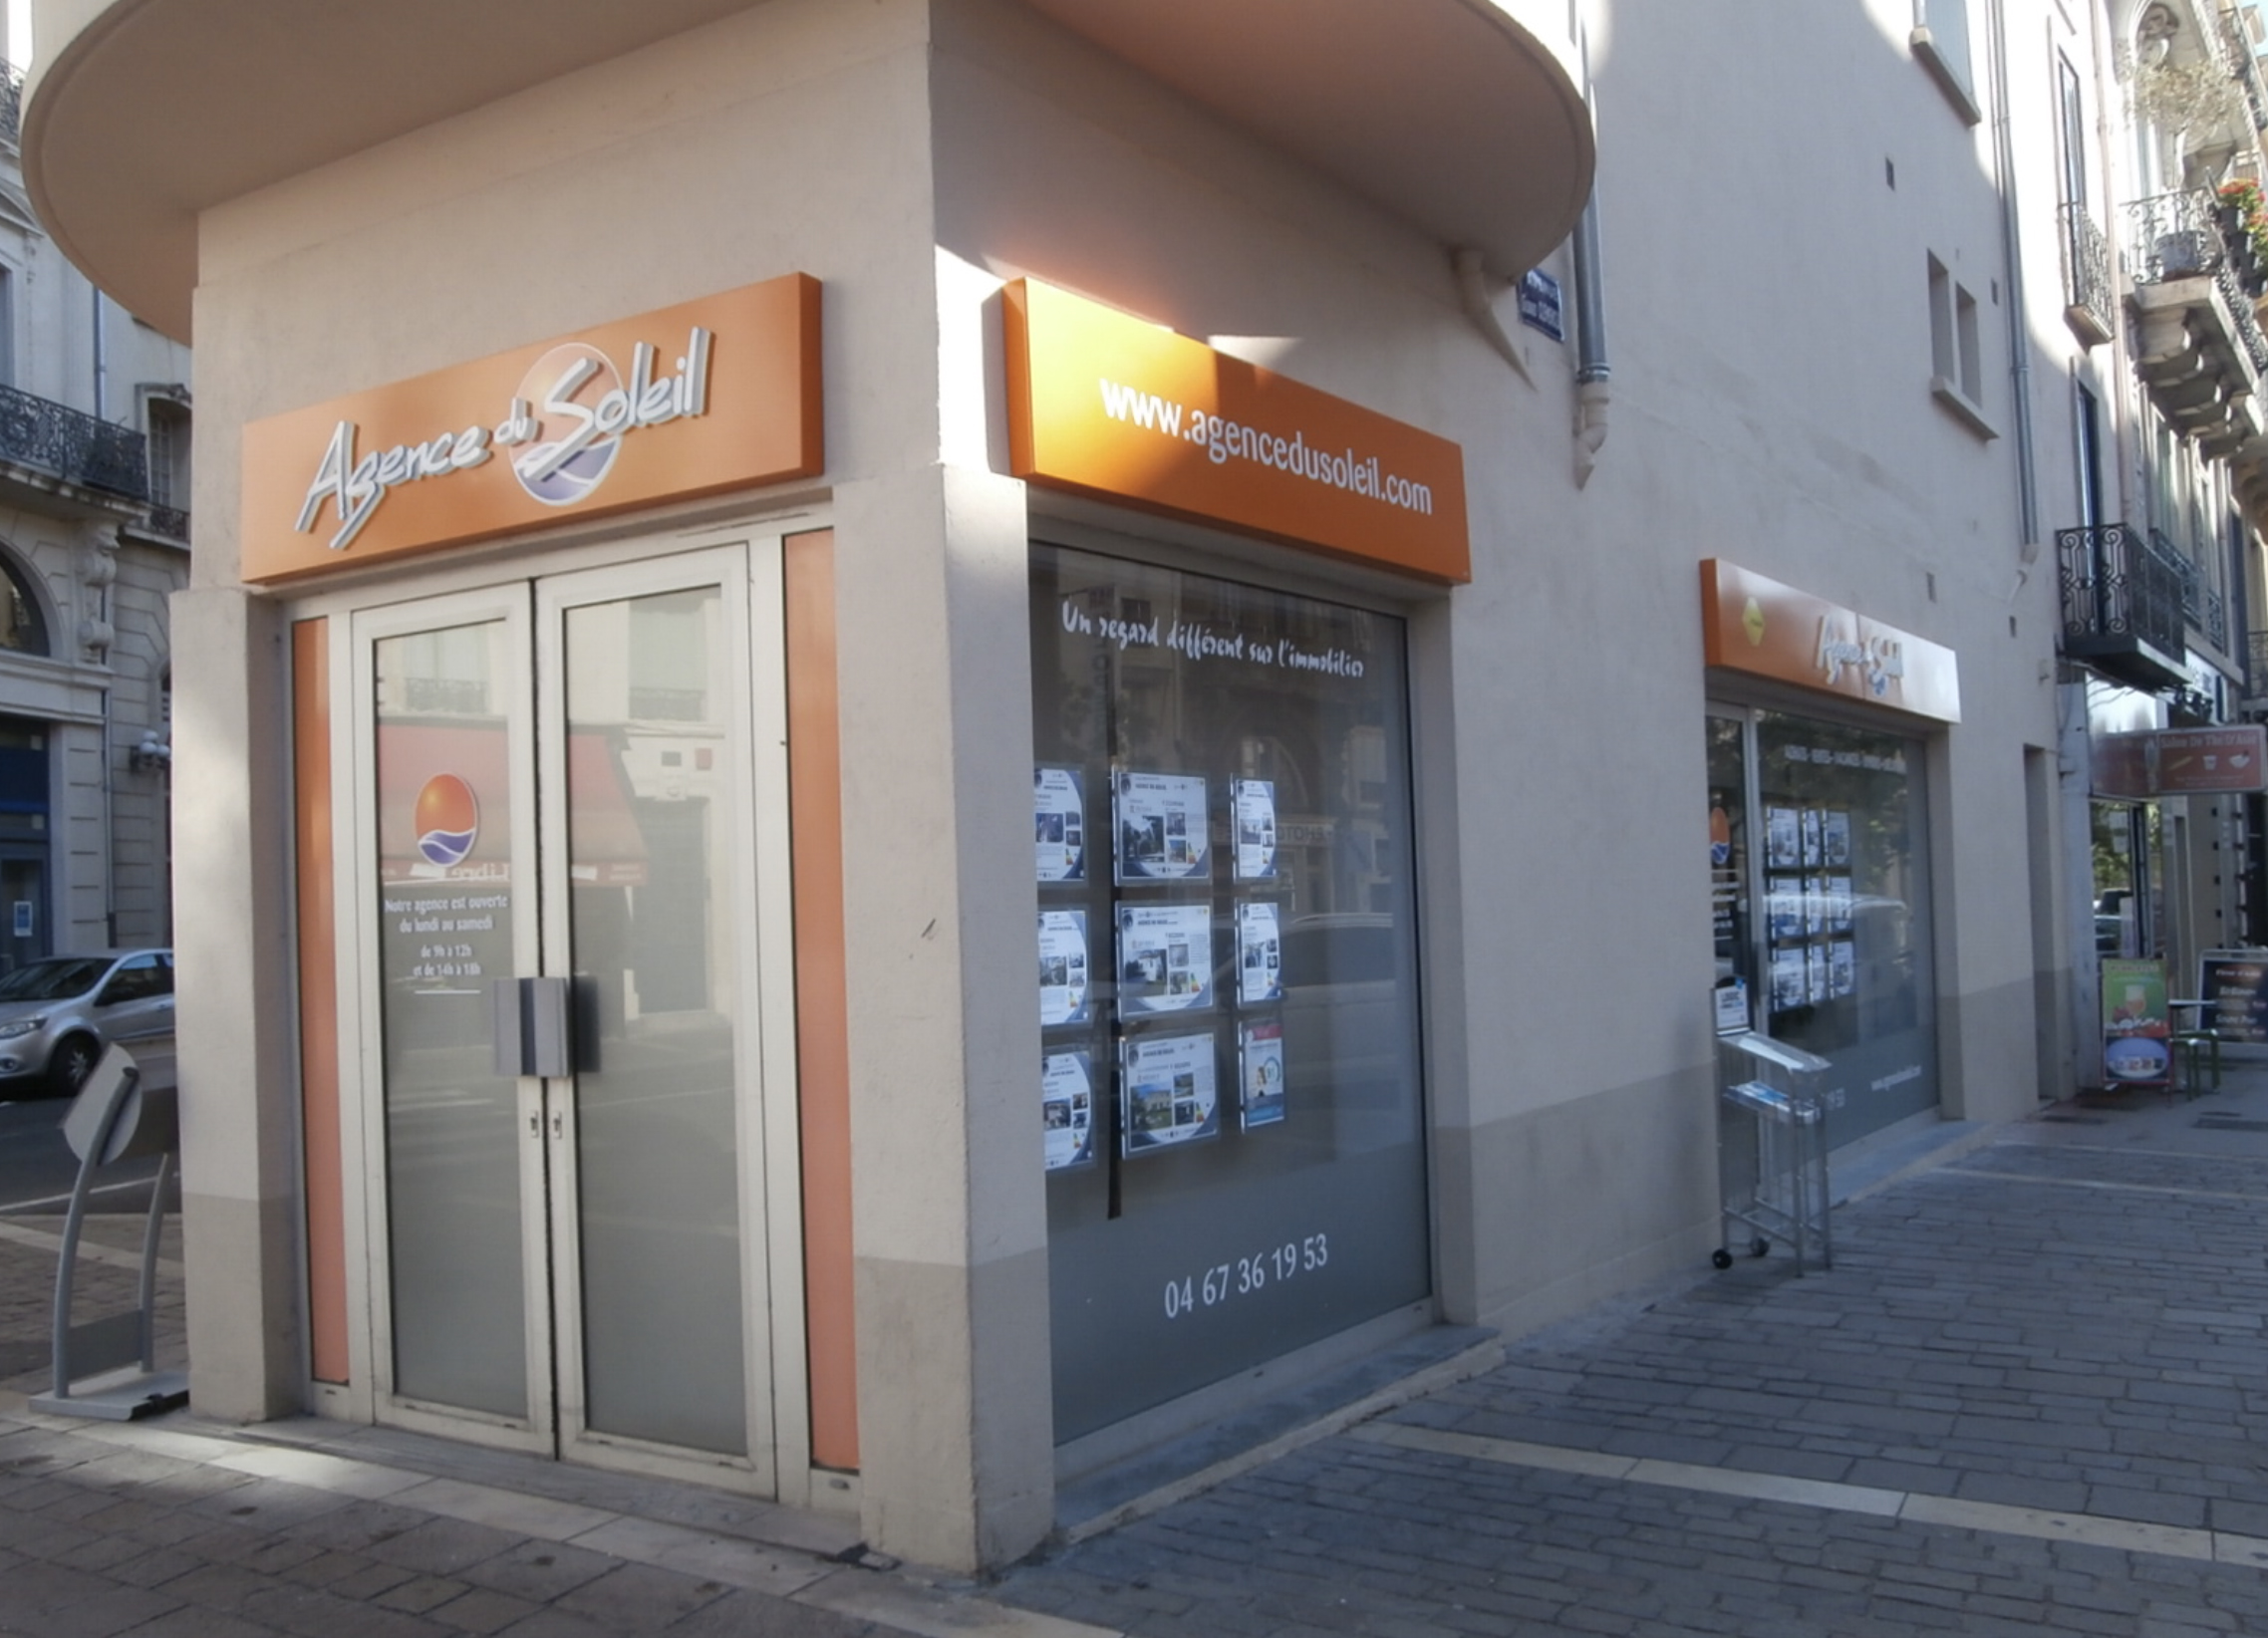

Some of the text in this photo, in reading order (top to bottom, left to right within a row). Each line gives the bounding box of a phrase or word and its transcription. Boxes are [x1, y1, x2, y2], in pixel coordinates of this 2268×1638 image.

[295, 326, 714, 549] Agence du Soleil
[1099, 377, 1433, 516] www.agencedusoleil.com
[1062, 600, 1365, 679] Un regard différent sur l'immobilier
[384, 895, 509, 916] Notre agence est ouverte
[399, 919, 414, 933] du
[415, 918, 439, 932] lundi
[456, 915, 493, 931] samedi
[1164, 1232, 1328, 1318] 04 67 36 19 53
